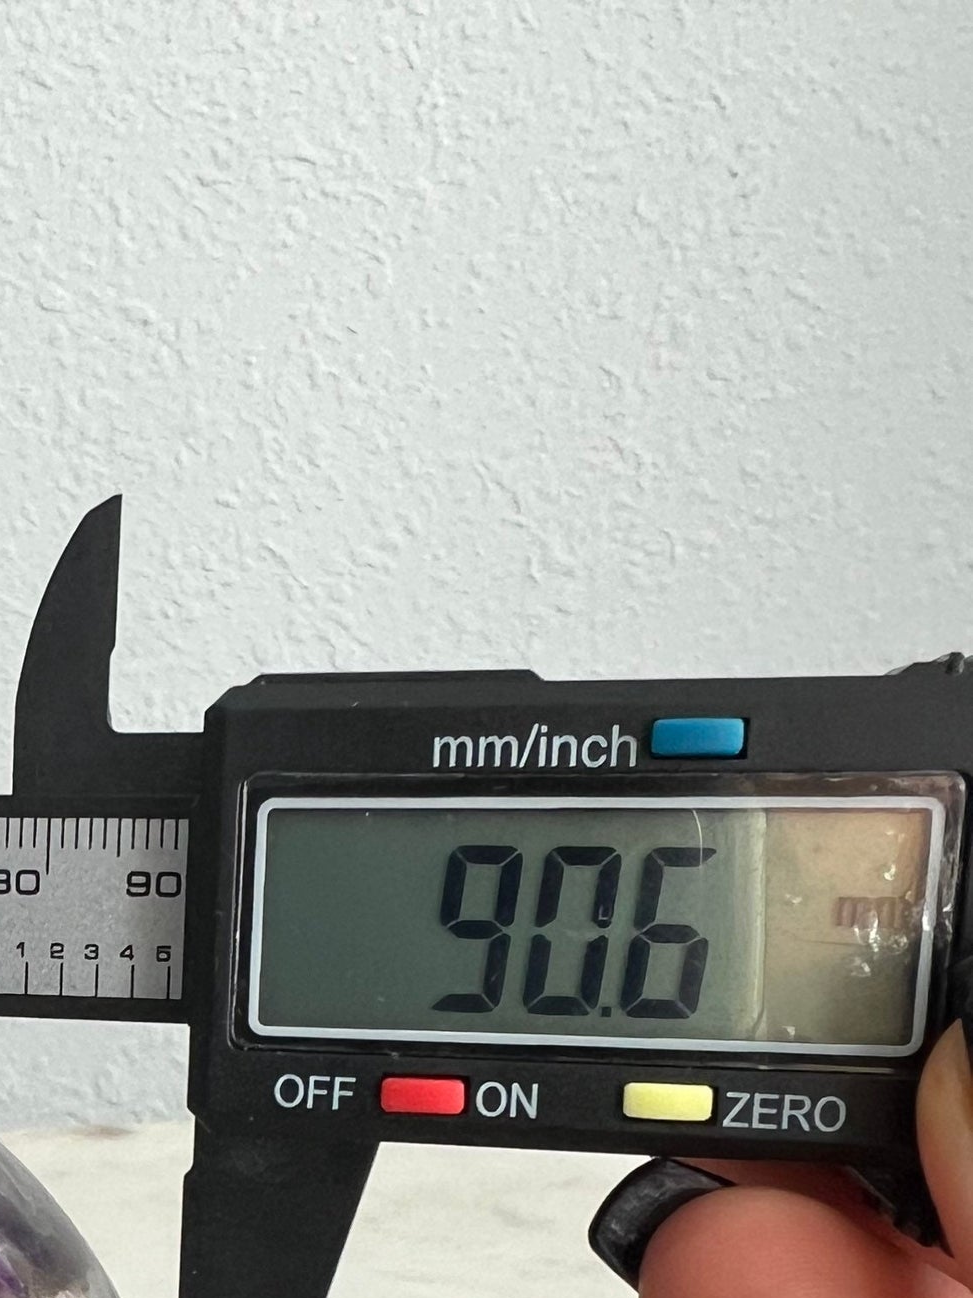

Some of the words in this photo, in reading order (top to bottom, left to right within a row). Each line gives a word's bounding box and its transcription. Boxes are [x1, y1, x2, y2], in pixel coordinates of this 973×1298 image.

[432, 722, 638, 770] mm/inch
[126, 870, 182, 898] 90
[16, 941, 25, 958] 1
[50, 942, 64, 959] 2
[84, 943, 99, 961] 3
[119, 944, 135, 961] 4
[274, 1072, 357, 1110] OFF
[475, 1081, 539, 1119] ON
[722, 1091, 848, 1133] ZERO
